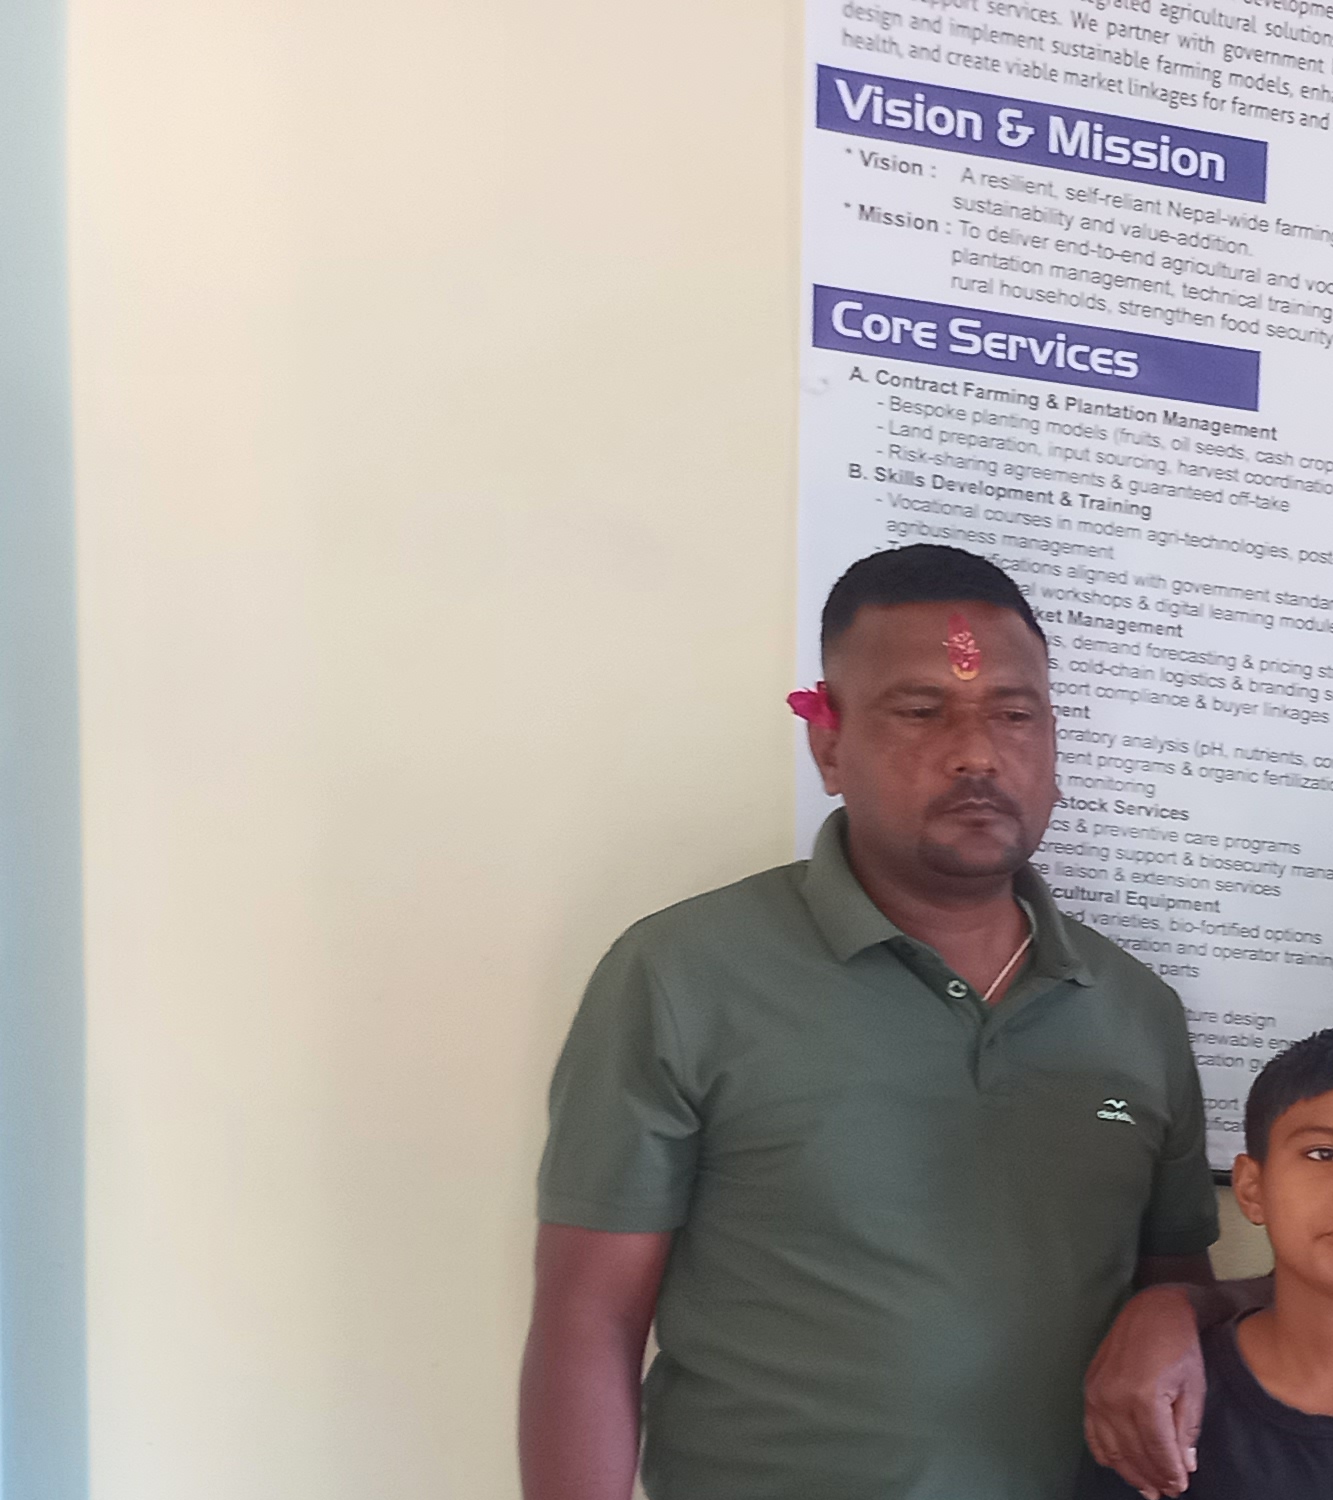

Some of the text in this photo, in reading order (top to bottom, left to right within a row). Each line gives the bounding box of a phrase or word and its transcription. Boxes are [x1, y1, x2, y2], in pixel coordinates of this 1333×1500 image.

[842, 1, 902, 29] design
[909, 16, 941, 33] and
[949, 18, 1044, 51] implement
[1051, 41, 1149, 69] sustainable
[1156, 55, 1221, 87] farming
[1071, 10, 1097, 31] We
[1107, 22, 1169, 44] partner
[1178, 33, 1214, 53] with
[1223, 44, 1324, 73] government
[1160, 3, 1256, 32] agricultural
[908, 45, 940, 62] and
[946, 52, 1000, 72] create
[1005, 58, 1058, 82] viable
[1064, 71, 1123, 93] market
[1128, 78, 1197, 108] linkages
[1203, 91, 1226, 110] for
[1232, 96, 1294, 123] farmers
[1299, 113, 1329, 129] and
[835, 78, 1226, 182] Vision & Mission
[859, 149, 922, 175] Vision
[961, 167, 975, 184] A
[1066, 187, 1161, 214] self-reliant
[1168, 201, 1268, 231] Nepal-wide
[953, 197, 1074, 229] sustainability
[1080, 217, 1114, 233] and
[859, 204, 938, 231] Mission
[959, 220, 980, 238] To
[987, 226, 1049, 248] deliver
[1055, 240, 1155, 266] end-to-end
[1162, 257, 1260, 282] agricultural
[1266, 273, 1299, 288] and
[951, 277, 992, 293] rural
[1118, 300, 1214, 326] strengthen
[1221, 314, 1259, 334] food
[1266, 325, 1333, 348] security
[952, 248, 1042, 274] plantation
[1182, 283, 1261, 308] technical
[1268, 296, 1332, 323] training
[831, 300, 1138, 378] Core Services
[849, 366, 1276, 440] A. Contract Farming & Plantation Management
[848, 463, 1151, 520] B. Skills Development & Training
